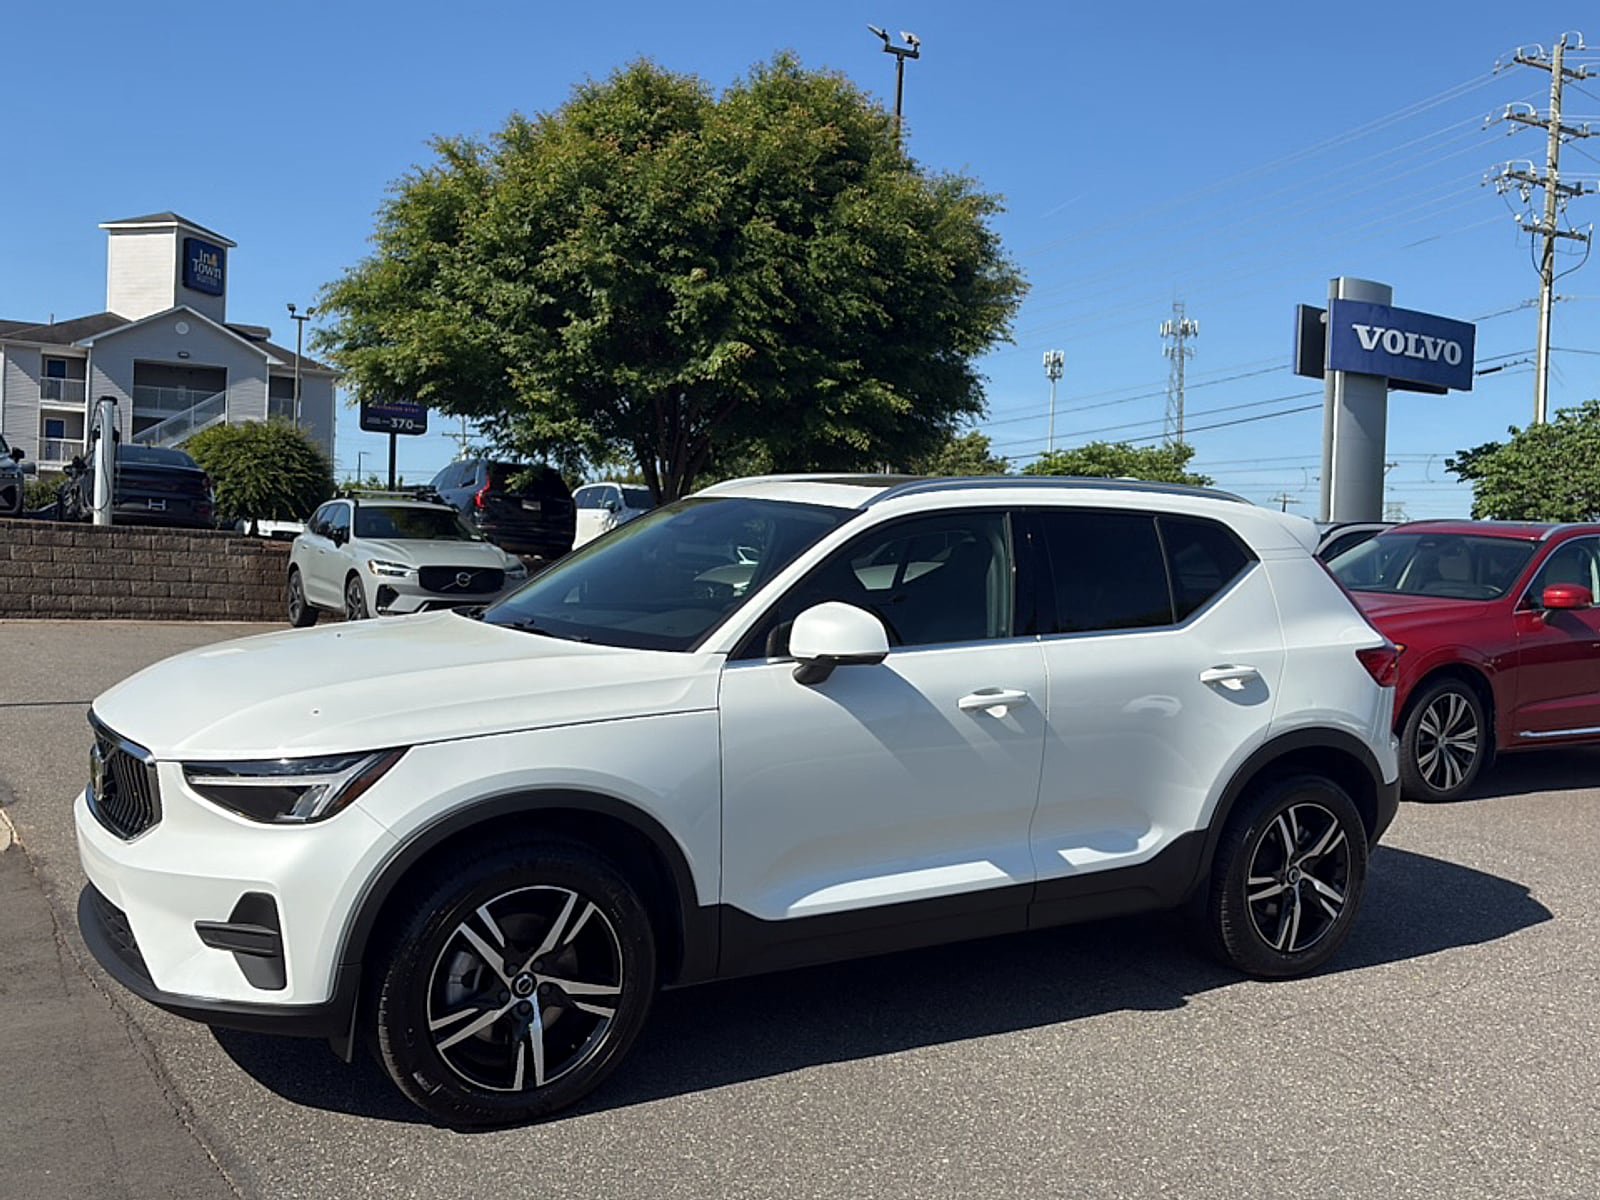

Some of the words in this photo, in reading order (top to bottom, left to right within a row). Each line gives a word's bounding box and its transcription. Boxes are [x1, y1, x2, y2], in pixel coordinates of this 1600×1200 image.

[199, 249, 210, 263] In
[192, 258, 222, 280] Town
[1352, 324, 1462, 365] VOLVO
[391, 417, 414, 430] 370
